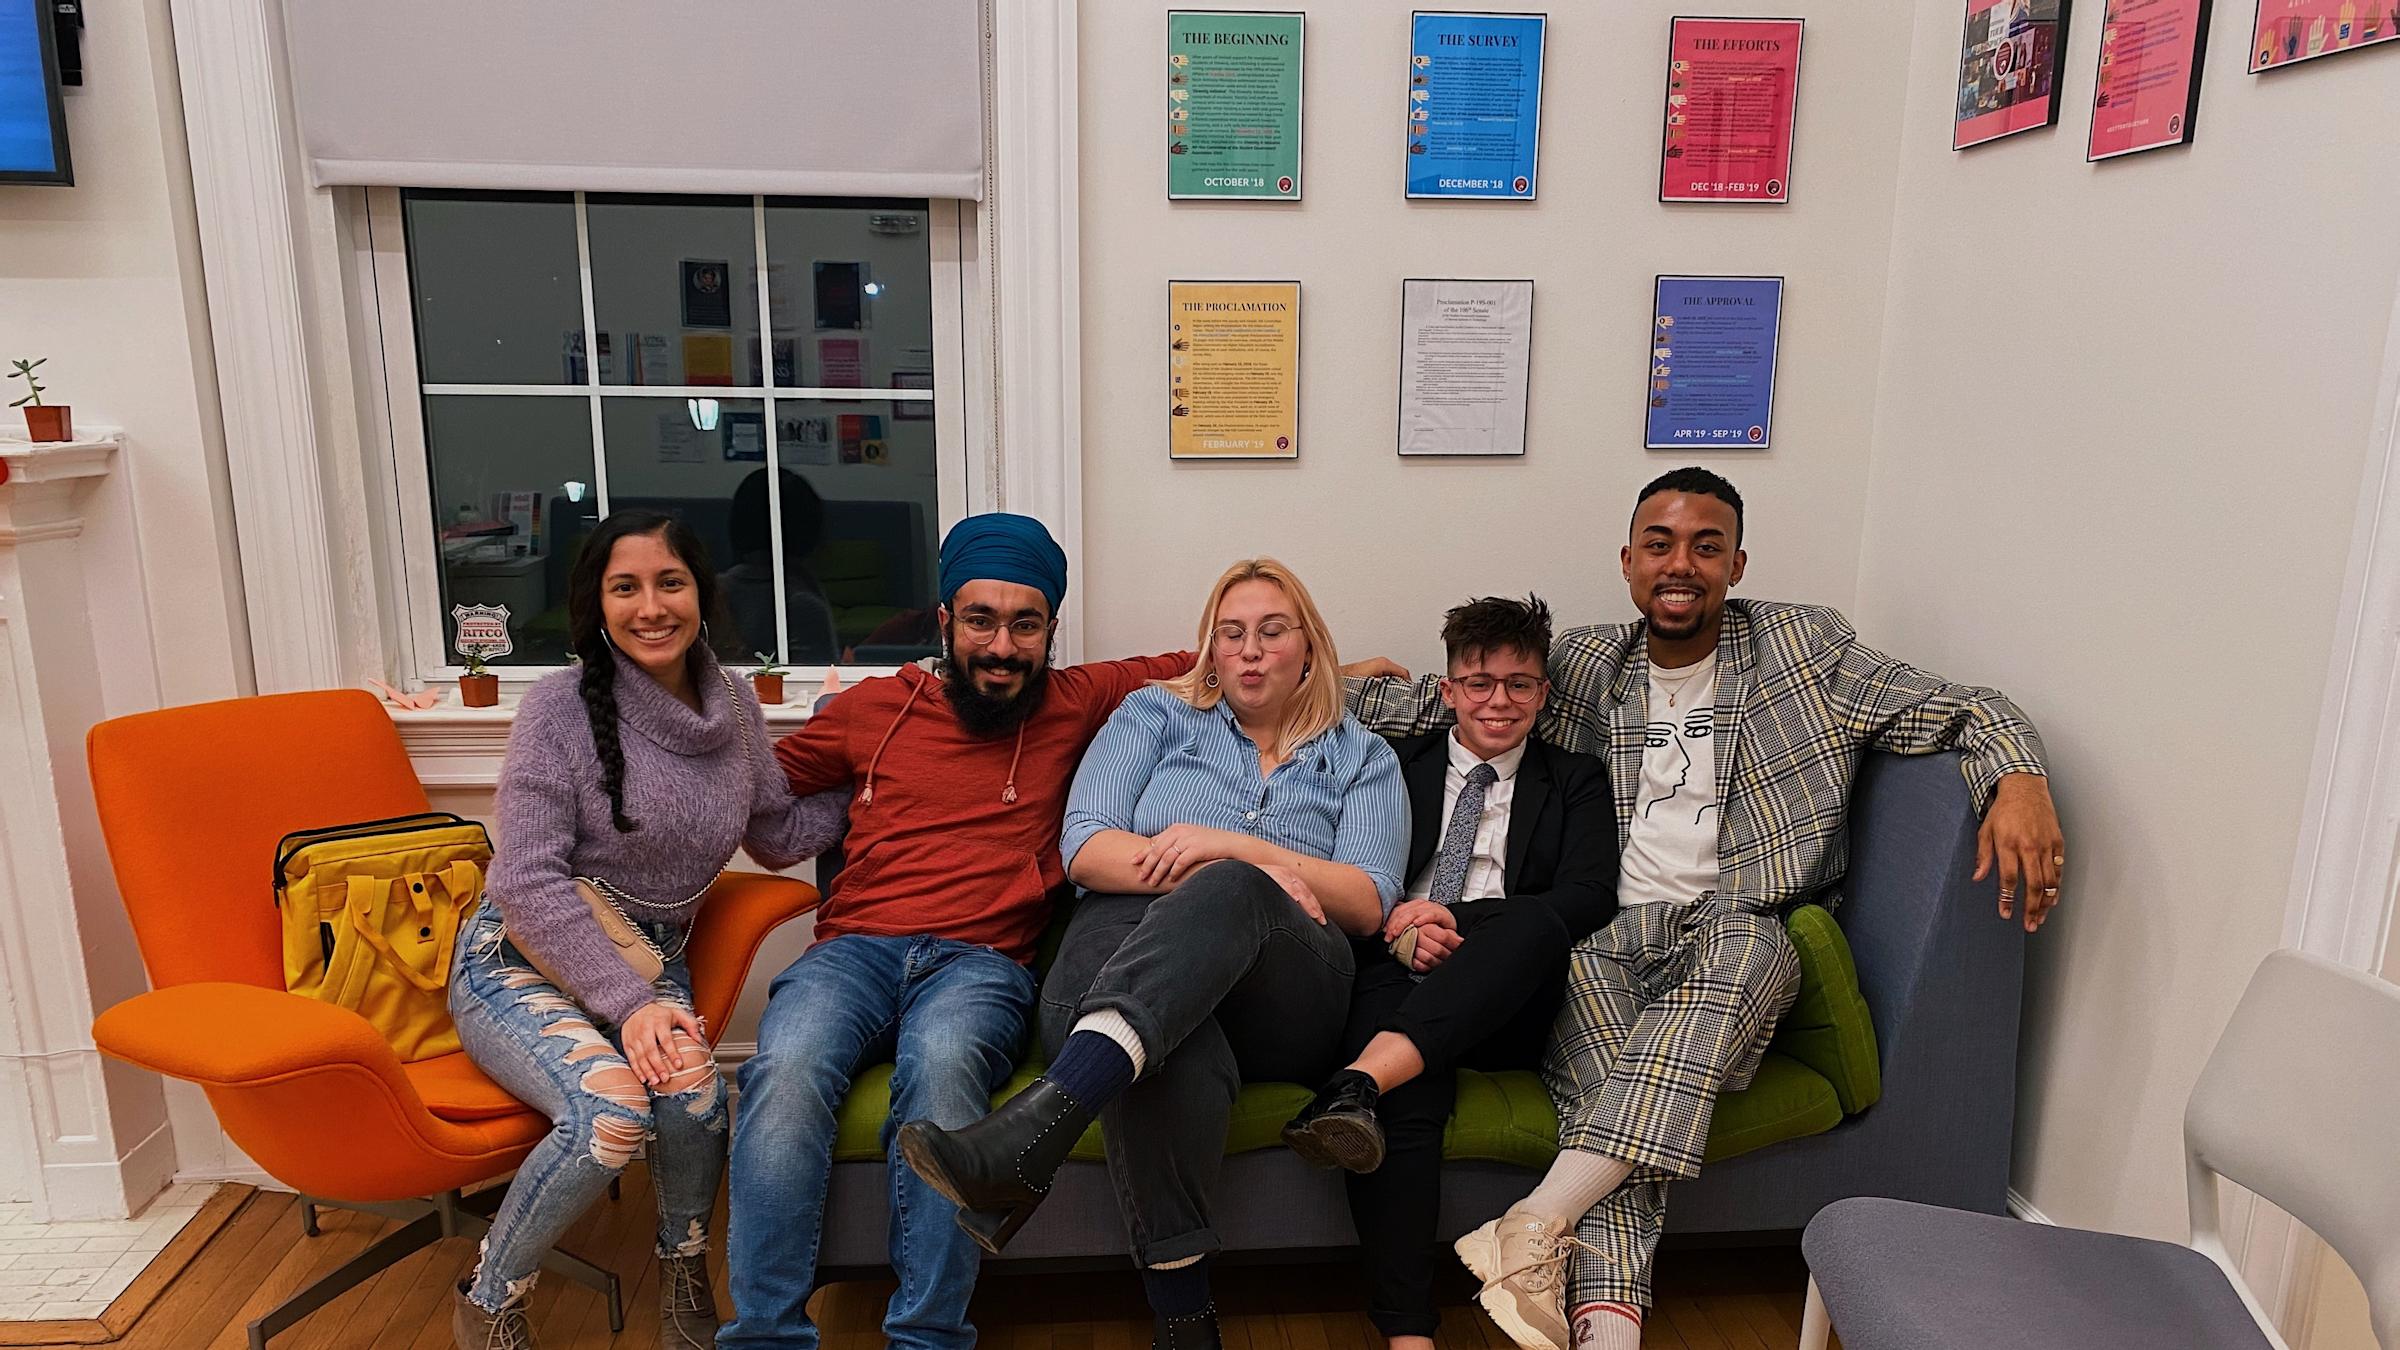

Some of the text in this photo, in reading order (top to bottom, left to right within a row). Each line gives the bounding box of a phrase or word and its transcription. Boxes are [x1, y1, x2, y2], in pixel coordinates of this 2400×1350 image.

[1182, 32, 1289, 46] THE BEGINNING
[1437, 33, 1519, 48] THE SURVEY
[1693, 38, 1780, 51] THE EFFORTS
[1203, 177, 1265, 187] OCTOBER '18
[1438, 178, 1504, 189] DECEMBER '18
[1690, 182, 1709, 191] DEC
[1710, 182, 1724, 192] '18
[1746, 183, 1760, 192] '19
[1683, 296, 1756, 307] THE APPROVAL
[1182, 302, 1287, 312] THE PROCLAMATION
[1673, 429, 1692, 438] APR
[1693, 429, 1706, 438] '19
[1712, 429, 1729, 438] SEP
[1729, 429, 1743, 438] '19
[1202, 439, 1265, 449] FEBRUARY '19
[463, 628, 503, 638] RITCO
